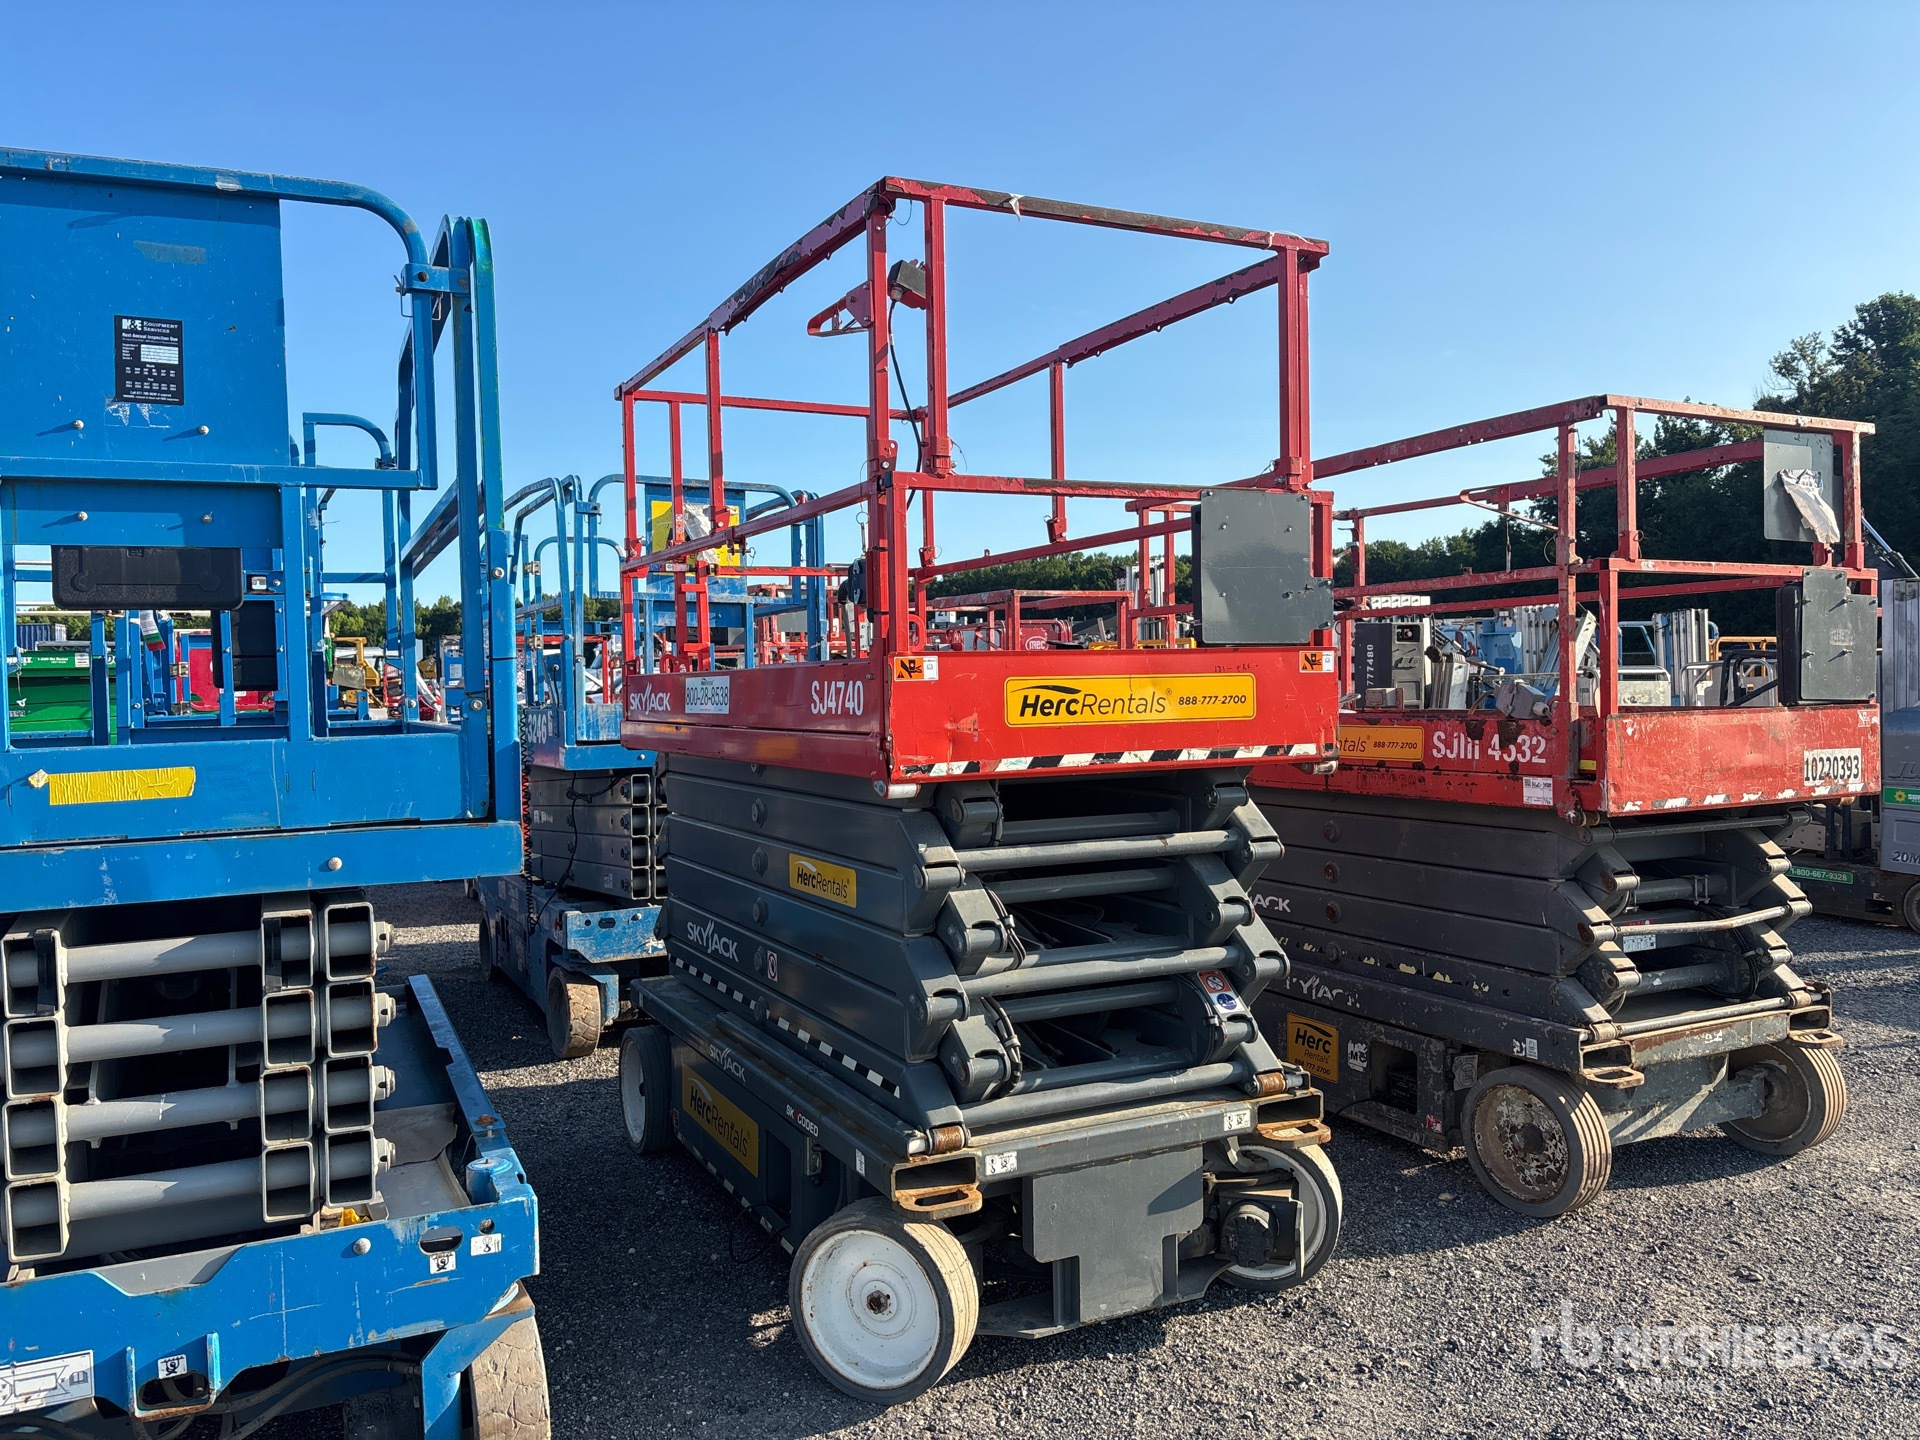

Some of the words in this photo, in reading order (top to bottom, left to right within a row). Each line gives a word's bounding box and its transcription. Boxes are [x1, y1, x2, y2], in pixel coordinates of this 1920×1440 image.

[1366, 644, 1375, 686] 777480
[629, 682, 671, 715] SKYJACK
[686, 685, 729, 706] 800-28-8538
[811, 680, 864, 716] SJ4740
[1178, 694, 1247, 706] 888-777-2700
[1373, 740, 1418, 750] 888-777-2700
[1804, 754, 1860, 782] 10220393
[1790, 867, 1848, 882] 1-800-667-9328
[687, 919, 740, 963] SKYJACK
[1294, 1026, 1332, 1055] Herc
[708, 1044, 746, 1082] SKYJACK
[1294, 1058, 1331, 1076] 888-777-2700
[1303, 1049, 1330, 1065] Rentals
